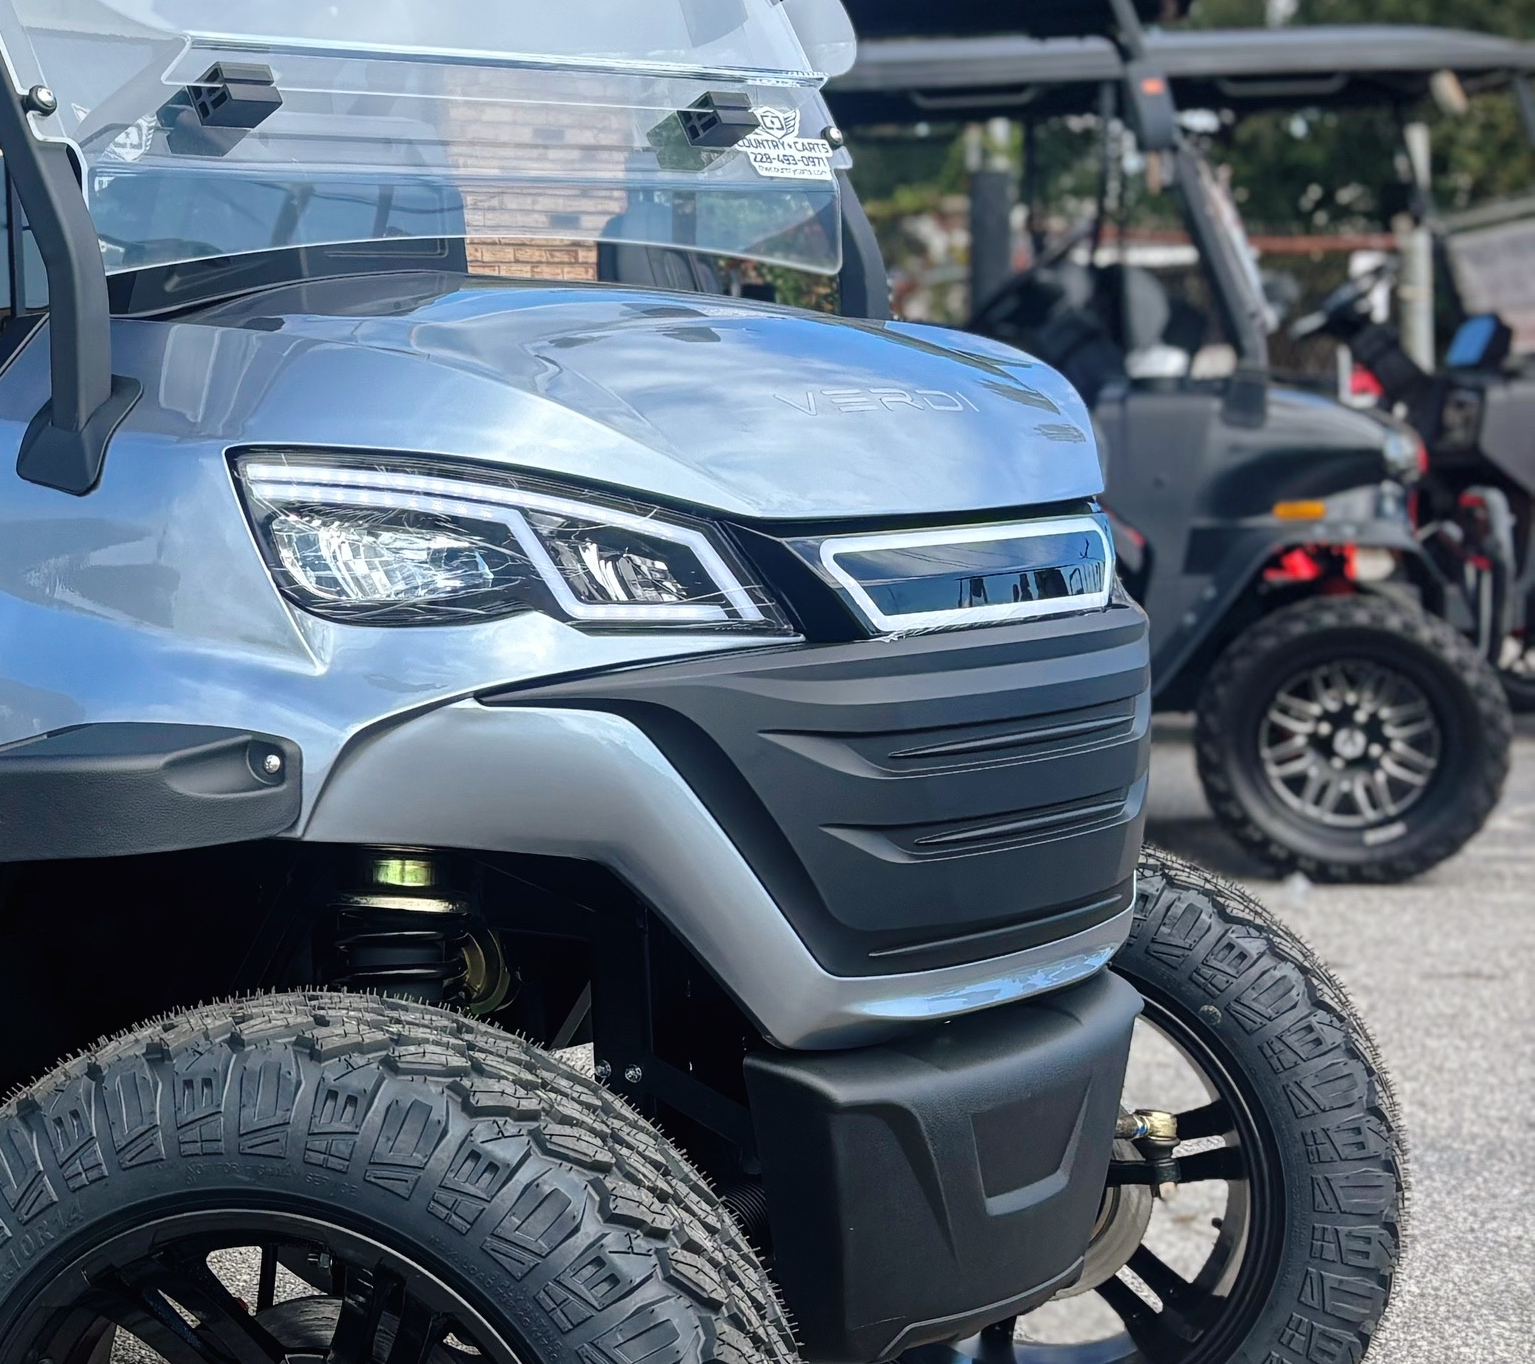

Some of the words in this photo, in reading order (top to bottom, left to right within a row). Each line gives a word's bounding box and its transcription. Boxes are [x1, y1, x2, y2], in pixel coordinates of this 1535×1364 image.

[736, 138, 785, 150] COUNTRY
[793, 142, 829, 153] CARTS
[751, 152, 826, 166] 228-493-0971
[773, 389, 979, 416] VERDI
